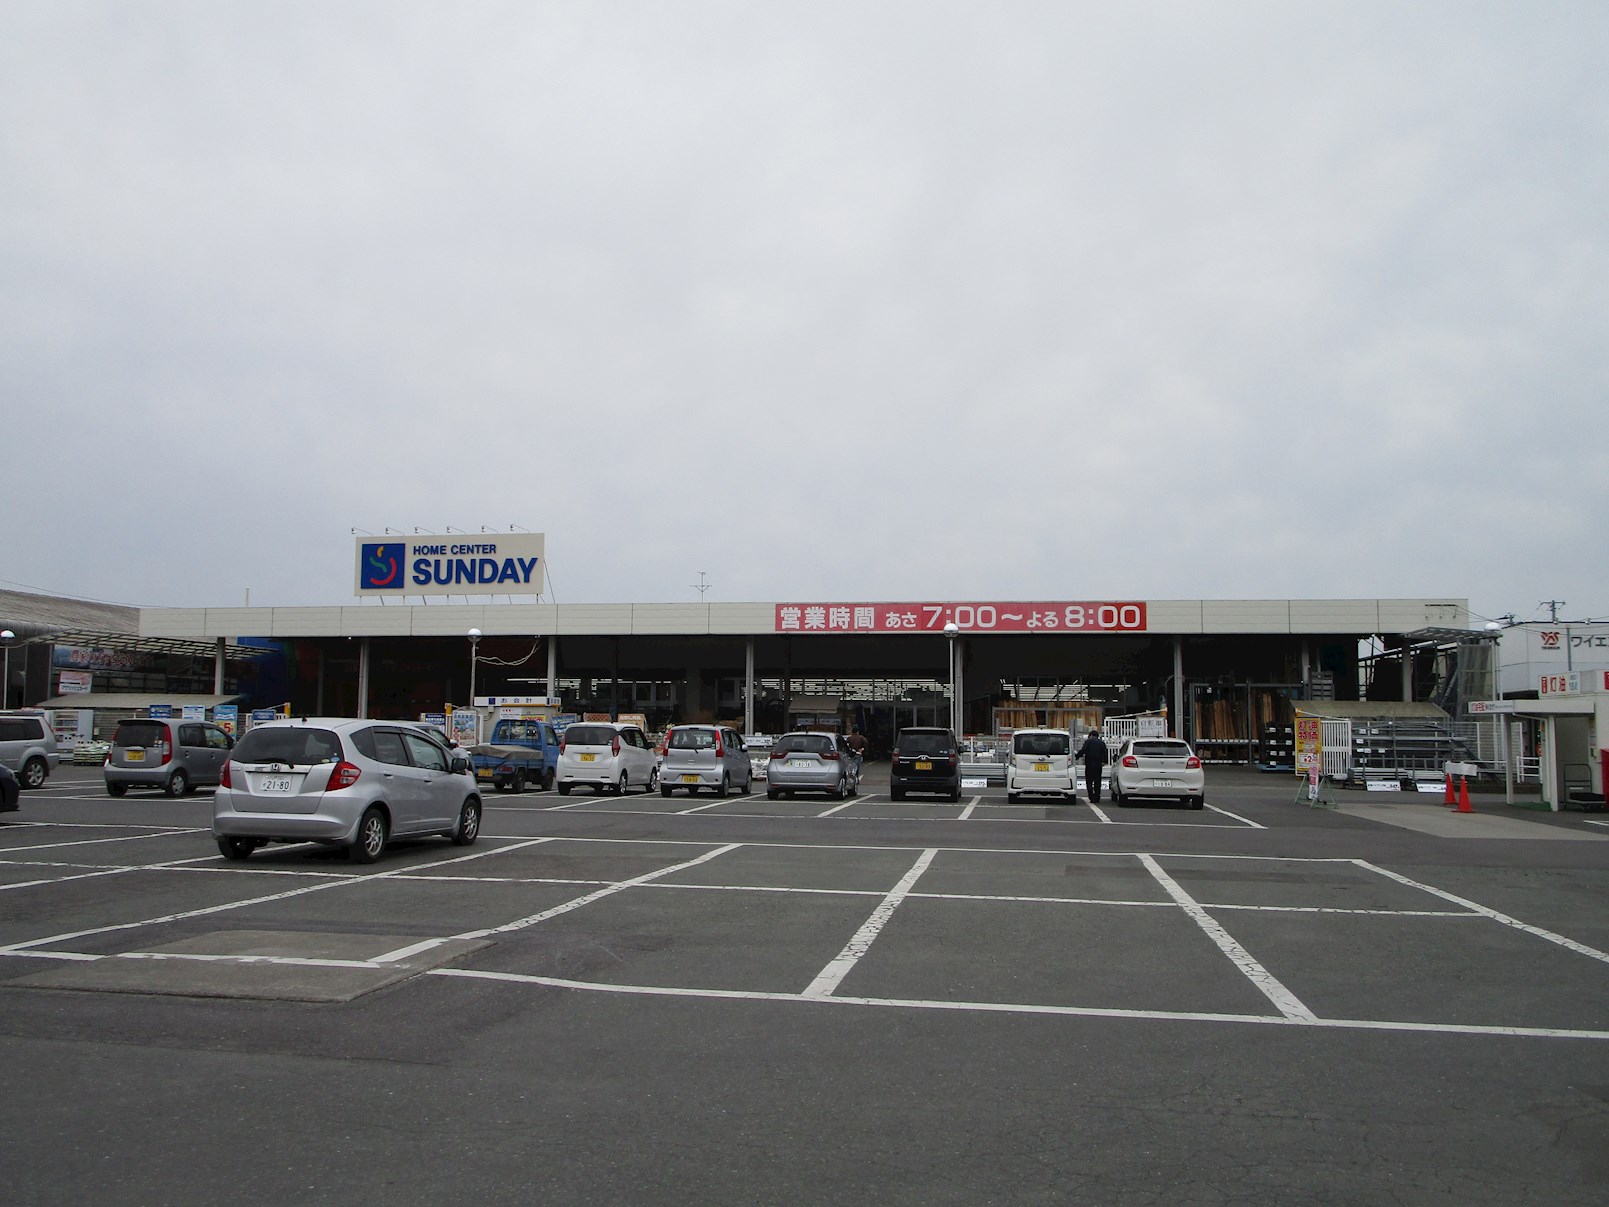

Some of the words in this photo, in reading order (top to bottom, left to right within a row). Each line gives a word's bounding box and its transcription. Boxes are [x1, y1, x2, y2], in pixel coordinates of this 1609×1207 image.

[413, 544, 447, 556] HOME
[450, 544, 497, 555] CENTER
[412, 557, 538, 585] SUNDAY
[780, 606, 875, 629] 営業時間
[1570, 635, 1609, 648] ワイエ
[266, 780, 290, 790] 21-80
